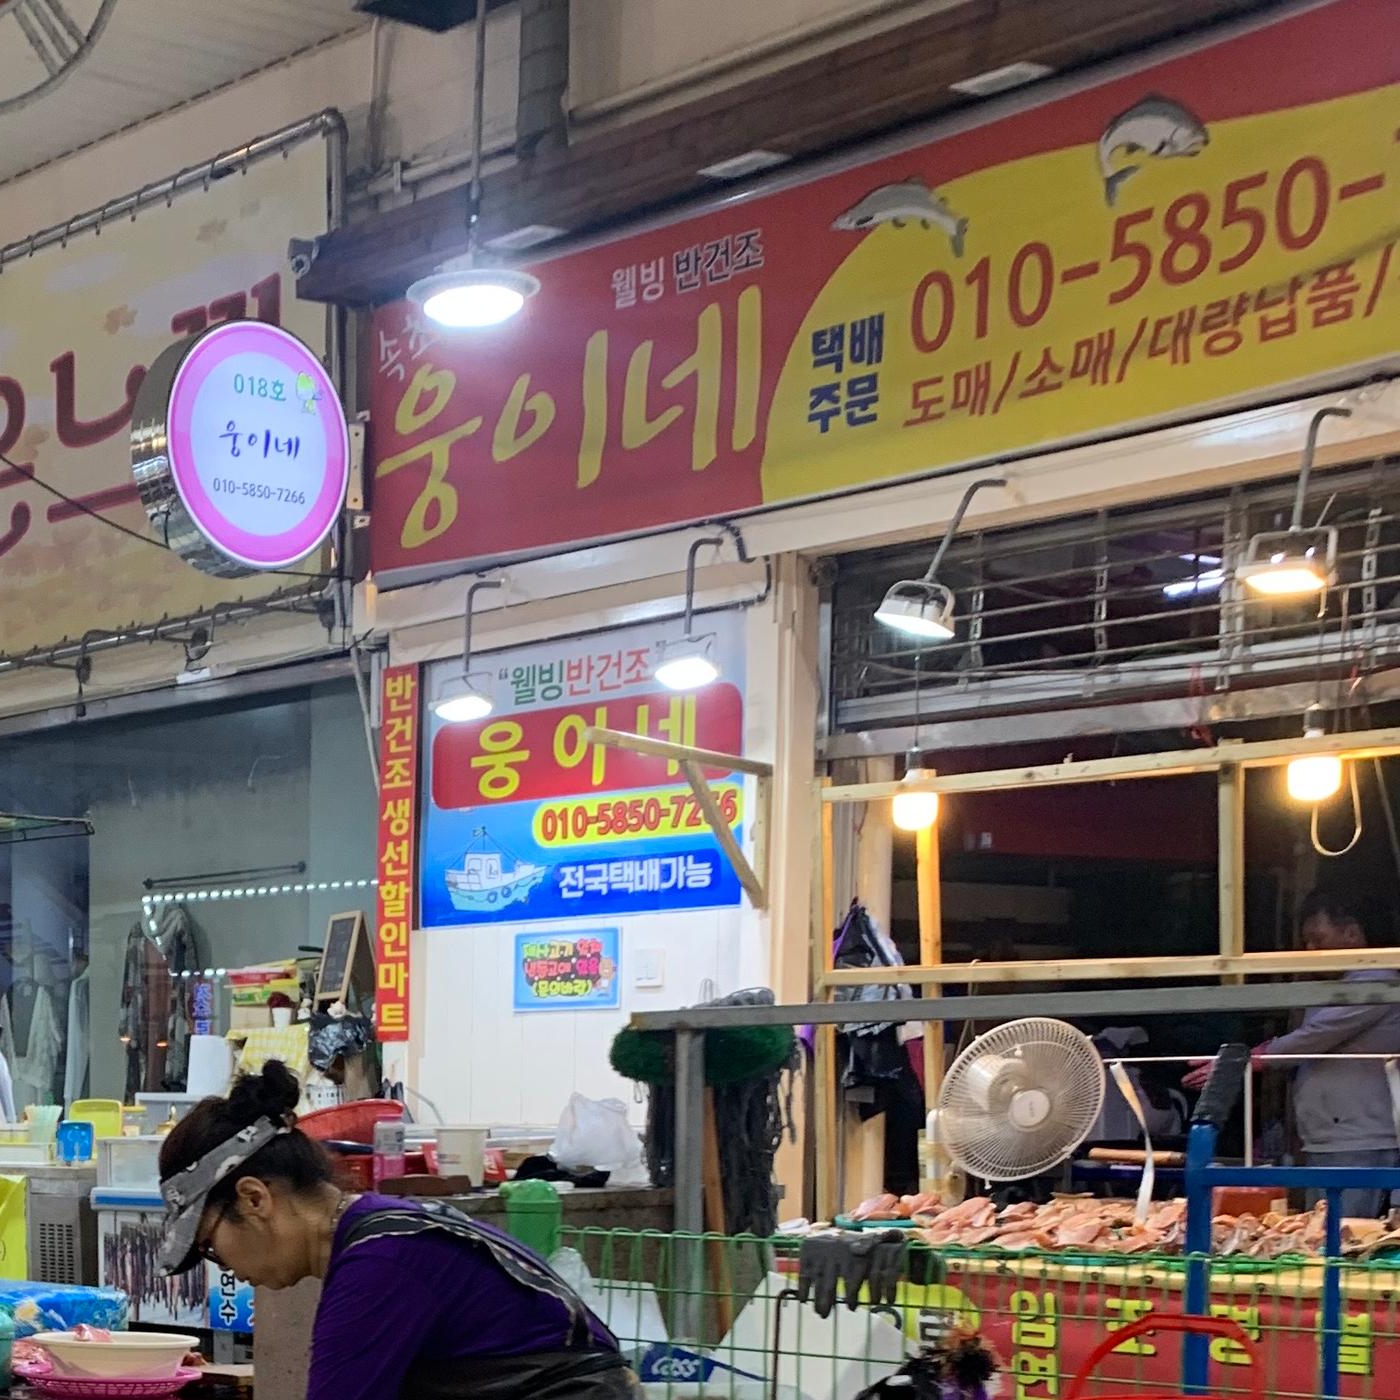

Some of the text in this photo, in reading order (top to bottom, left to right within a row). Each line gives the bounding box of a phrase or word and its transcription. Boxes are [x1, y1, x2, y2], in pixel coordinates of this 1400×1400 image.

[611, 229, 765, 310] 웰빙 반건조
[910, 128, 1400, 354] 010-5850-
[810, 312, 886, 374] 택배
[233, 373, 287, 402] 018호
[375, 284, 763, 549] 웅이네
[807, 372, 880, 434] 주문
[218, 420, 300, 459] 웅이네
[212, 477, 306, 506] 010-5850-7266
[471, 693, 697, 799] 웅이네
[558, 856, 713, 900] 전국택배가능
